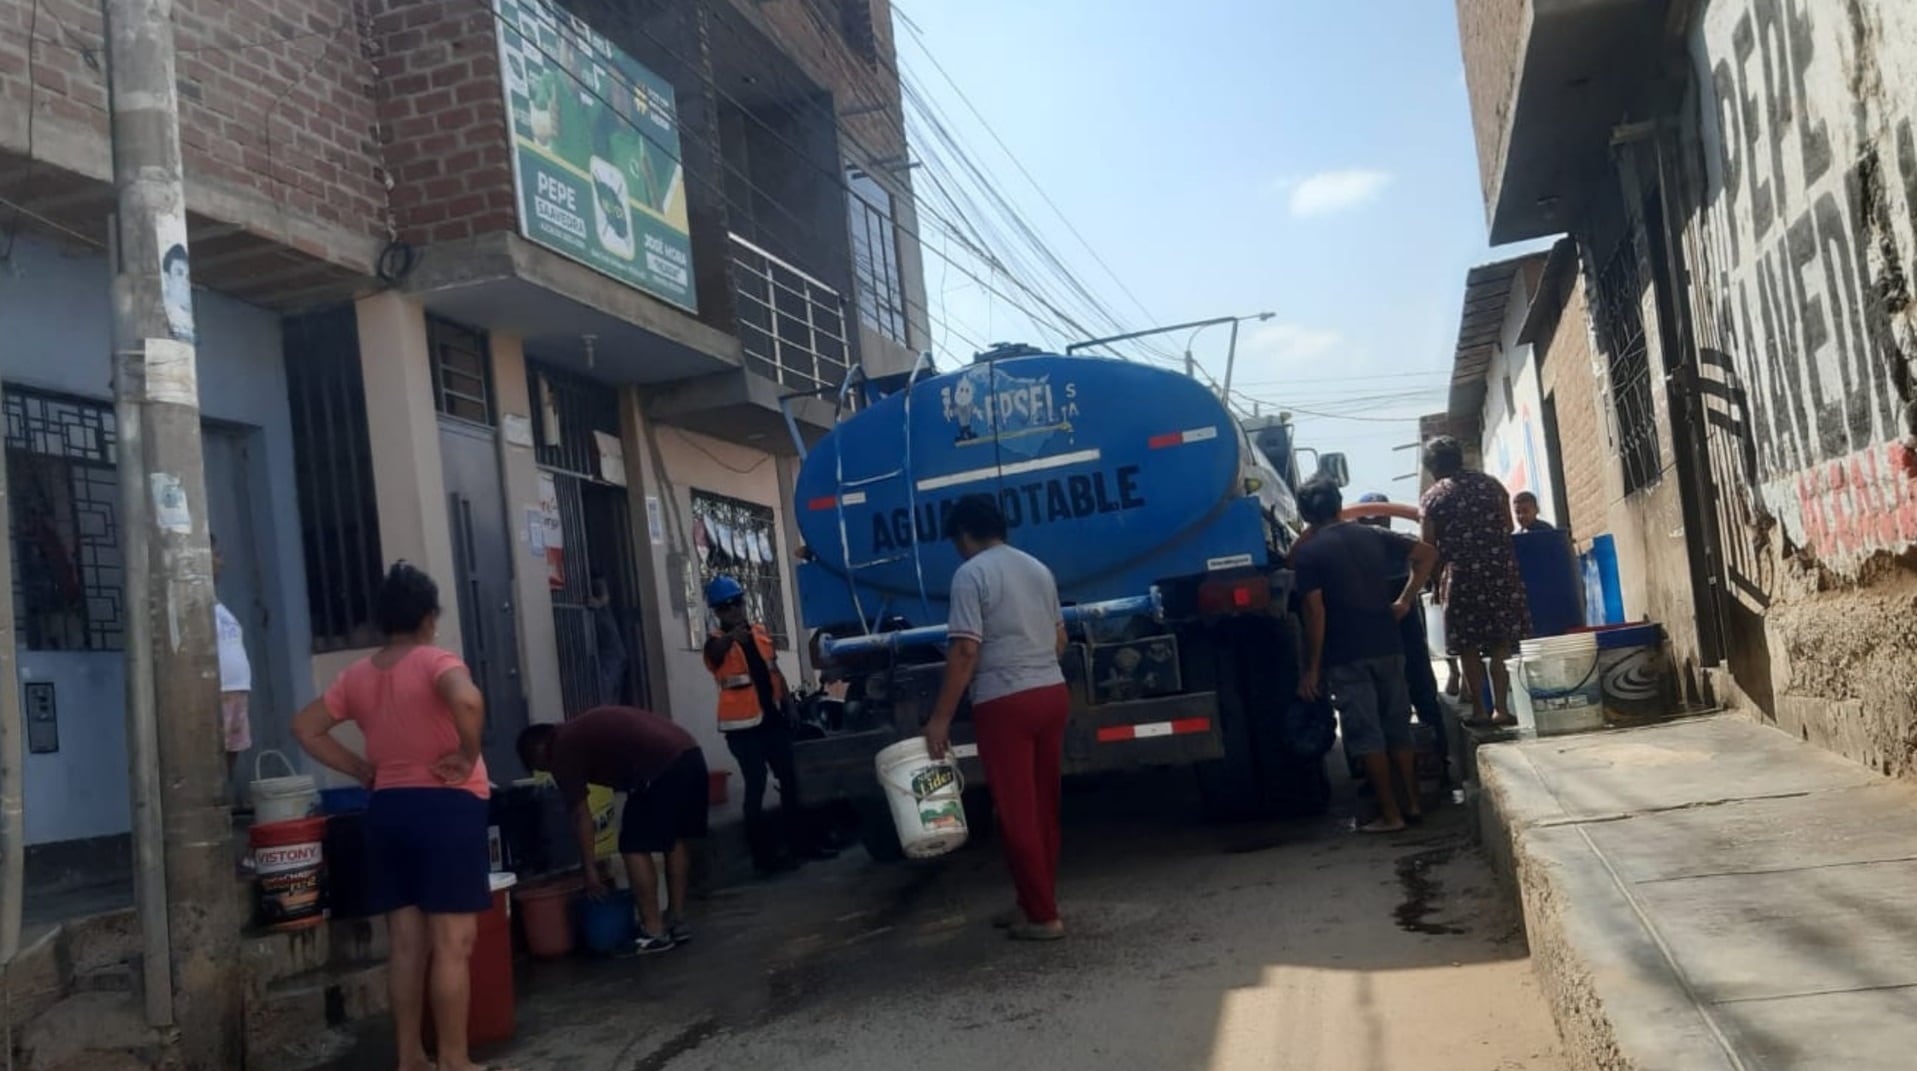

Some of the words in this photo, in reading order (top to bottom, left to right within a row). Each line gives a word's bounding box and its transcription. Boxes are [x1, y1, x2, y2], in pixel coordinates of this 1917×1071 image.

[537, 171, 576, 211] PEPE
[985, 464, 1146, 531] OTABLE
[257, 847, 316, 864] VISTONY
